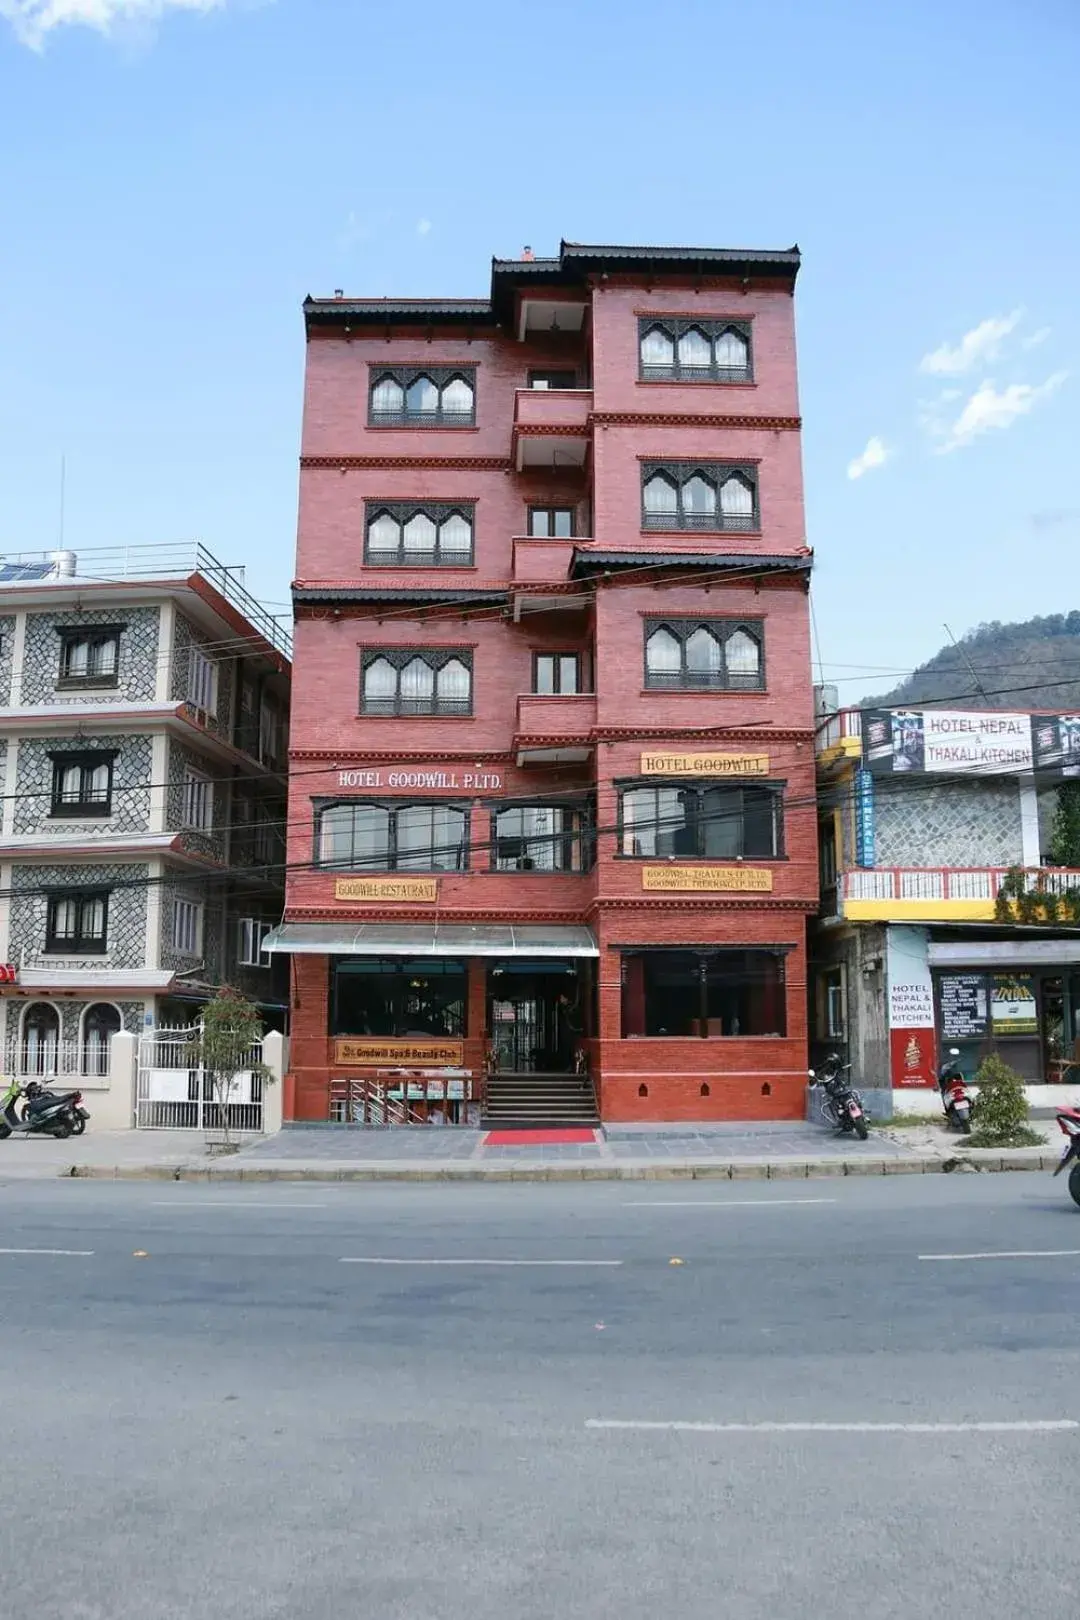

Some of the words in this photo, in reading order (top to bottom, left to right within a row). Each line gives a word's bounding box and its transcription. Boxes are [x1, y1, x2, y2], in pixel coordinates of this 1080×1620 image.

[931, 719, 976, 733] HOTEL
[980, 719, 1025, 734] NEPAL
[928, 746, 978, 761] THAKALI
[980, 747, 1030, 762] KITCHEN
[646, 758, 691, 771] HOTEL
[693, 758, 761, 771] GOODWILL
[339, 771, 383, 787] HOTEL
[388, 772, 459, 788] GOODWILL
[338, 884, 379, 897] GOODWILL
[380, 884, 434, 897] RESTAURANT
[357, 1048, 388, 1058] Goodwill
[390, 1048, 403, 1059] Spa
